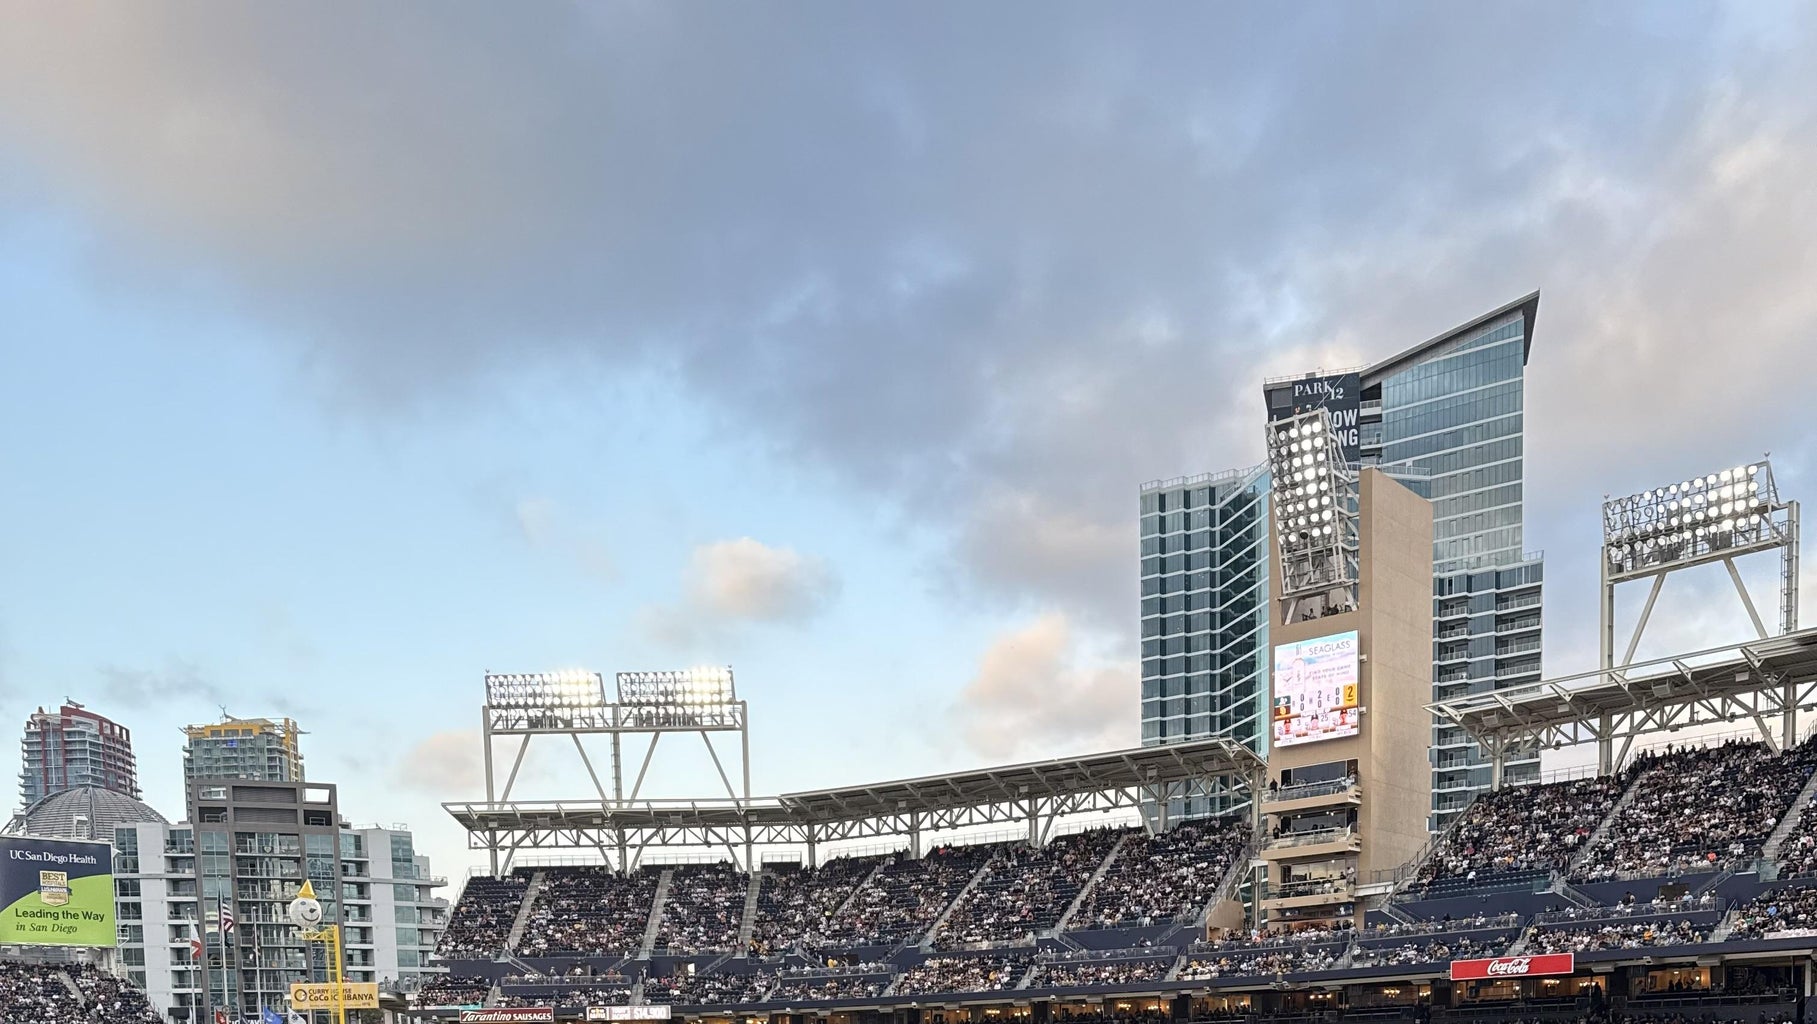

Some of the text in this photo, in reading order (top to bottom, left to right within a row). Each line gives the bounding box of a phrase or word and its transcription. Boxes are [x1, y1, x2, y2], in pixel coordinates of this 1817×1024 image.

[1294, 381, 1332, 397] PARK
[1309, 641, 1351, 656] SEAGLASS
[10, 850, 97, 865] UC San Diego Health
[41, 872, 65, 881] BEST
[15, 908, 105, 922] Leading the Way
[16, 921, 78, 934] in San Diego
[462, 1011, 552, 1021] Tarantino SAUSAGES
